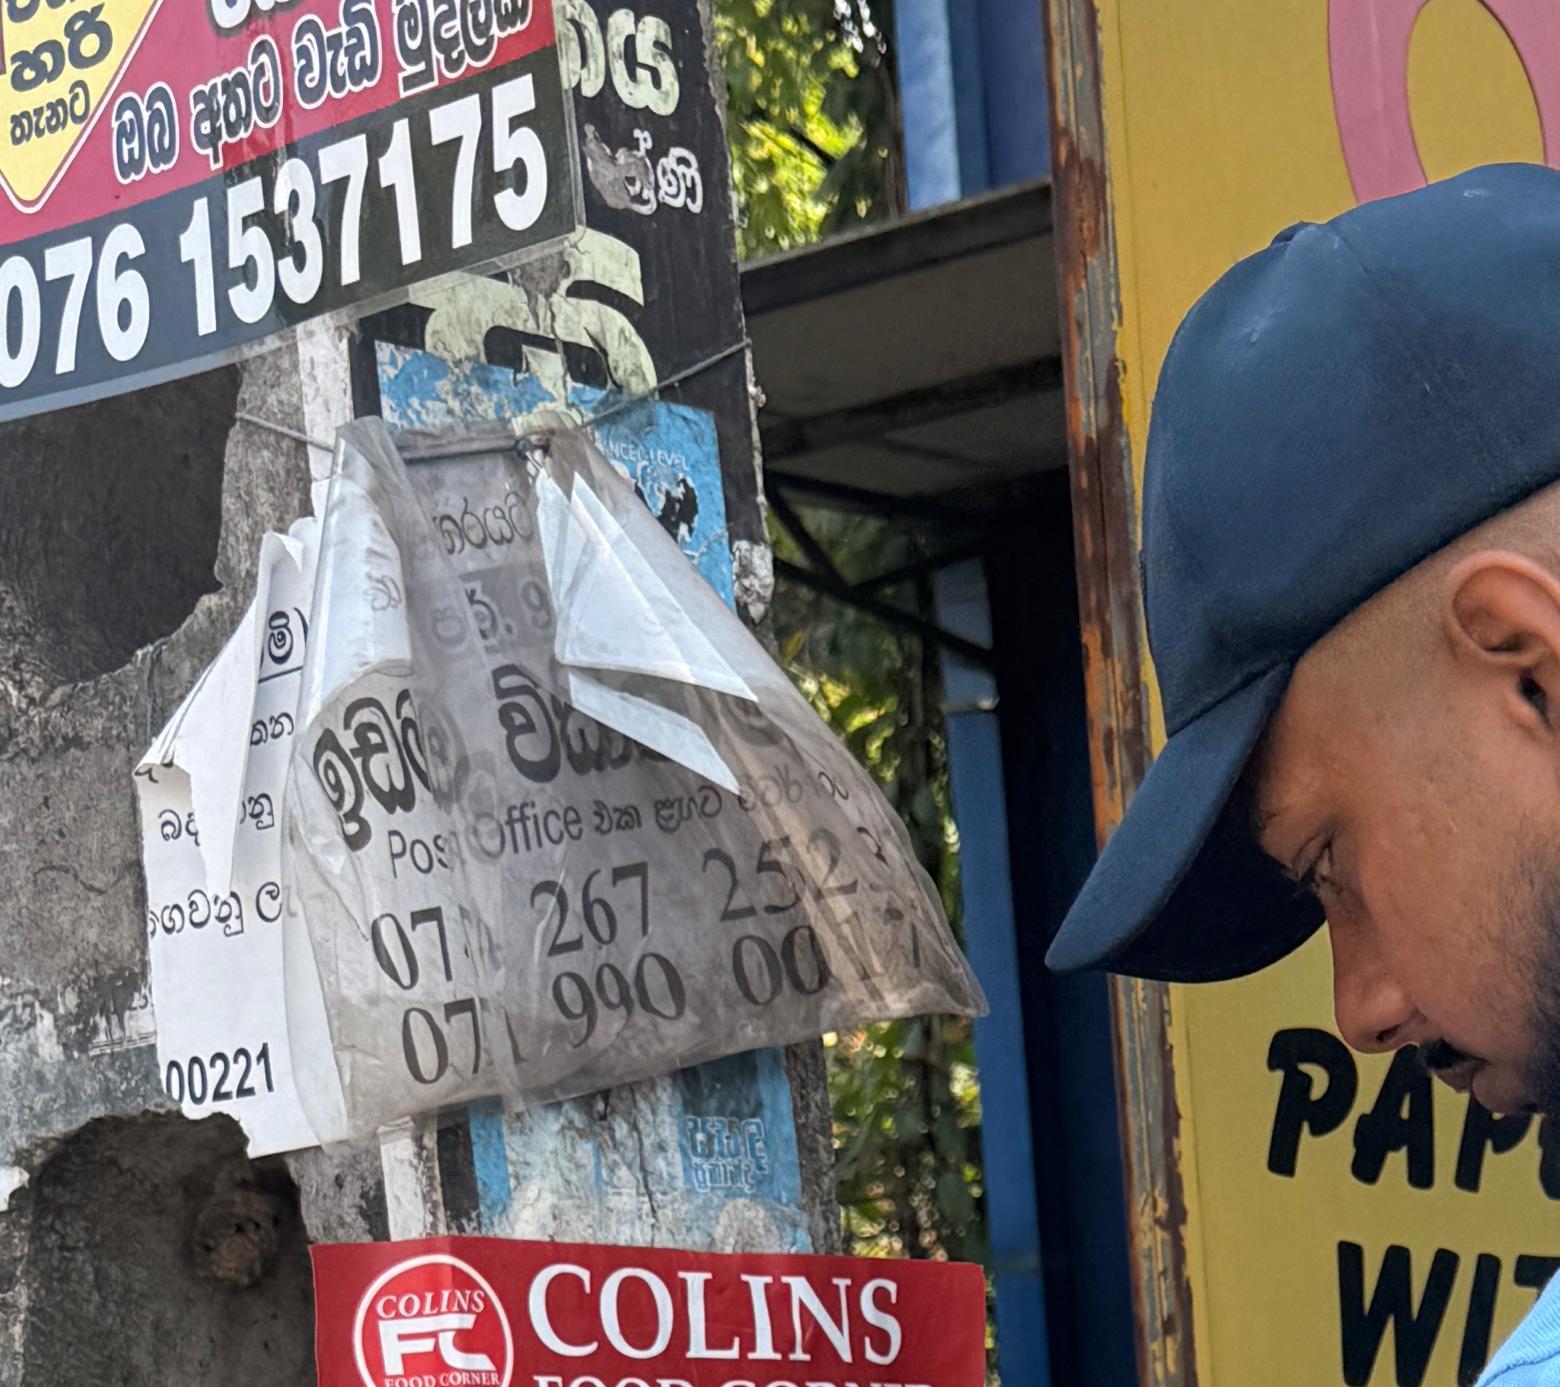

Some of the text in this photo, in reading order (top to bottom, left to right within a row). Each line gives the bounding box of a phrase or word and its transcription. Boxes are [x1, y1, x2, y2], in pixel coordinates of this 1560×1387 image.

[112, 82, 179, 184] ඔබ
[0, 224, 150, 388] 076
[179, 74, 548, 336] 1537175
[530, 861, 650, 957] 267
[551, 951, 686, 1049] 990
[376, 1289, 487, 1319] COLINS
[377, 1312, 498, 1377] FC
[528, 1262, 902, 1366] COLINS
